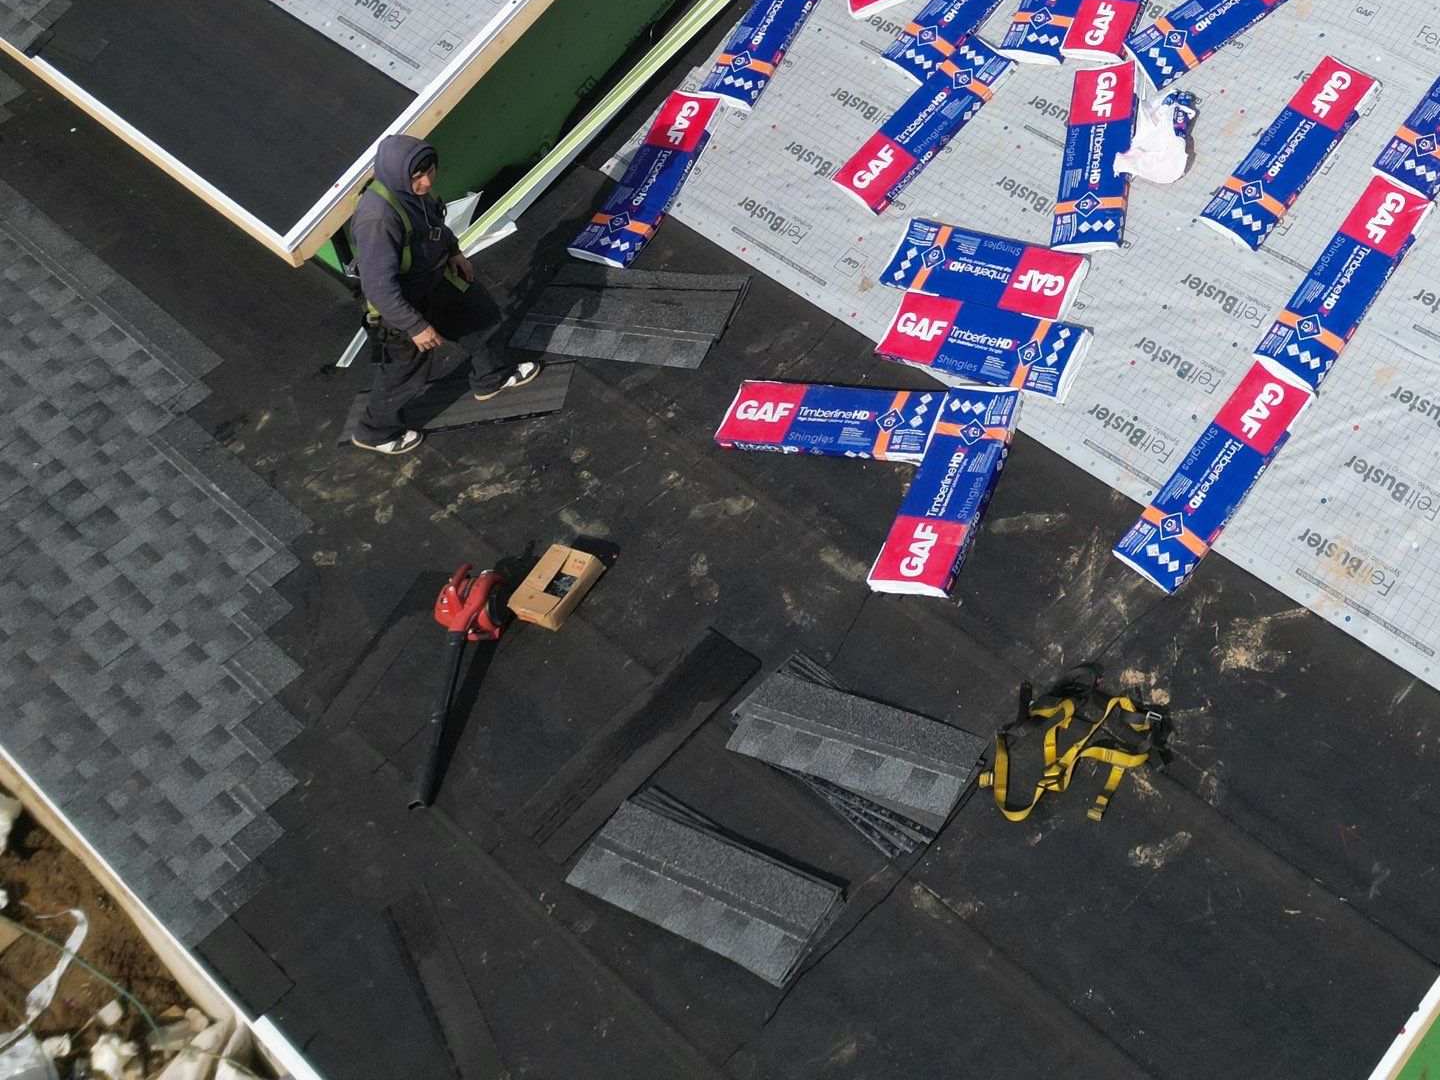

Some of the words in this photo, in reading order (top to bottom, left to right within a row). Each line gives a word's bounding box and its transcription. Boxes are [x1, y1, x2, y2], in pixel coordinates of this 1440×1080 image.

[1084, 1, 1120, 46] GAF
[1355, 7, 1374, 17] GAF
[1091, 72, 1117, 117] GAF
[1311, 70, 1351, 119] GAF
[666, 101, 699, 145] GAF
[894, 91, 947, 144] TimberlineHD
[1260, 110, 1292, 148] Shingles
[853, 145, 894, 189] GAF
[1065, 128, 1079, 167] Shingles
[1089, 123, 1107, 185] TimberlineHD
[1267, 119, 1316, 177] TimberlineHD
[737, 196, 808, 245] FeltBuster
[1365, 191, 1406, 244] GAF
[982, 239, 1022, 256] Shingles
[1313, 236, 1347, 278] Shingles
[949, 261, 1009, 283] TimberlineHD
[1012, 272, 1065, 296] GAF
[1327, 245, 1372, 310] TimberlineHD
[896, 312, 947, 340] GAF
[950, 325, 1012, 350] TimberlineHD
[937, 354, 978, 373] Shingles
[735, 400, 794, 422] GAF
[799, 406, 870, 421] TimberlineHD
[1240, 382, 1285, 439] GAF
[789, 431, 835, 445] Shingles
[1088, 403, 1176, 464] FeltBuster
[1182, 426, 1219, 471] Shingles
[926, 451, 965, 517] TimberlineHD
[1188, 440, 1243, 509] TimberlineHD
[958, 476, 983, 520] Shingles
[900, 522, 939, 578] GAF
